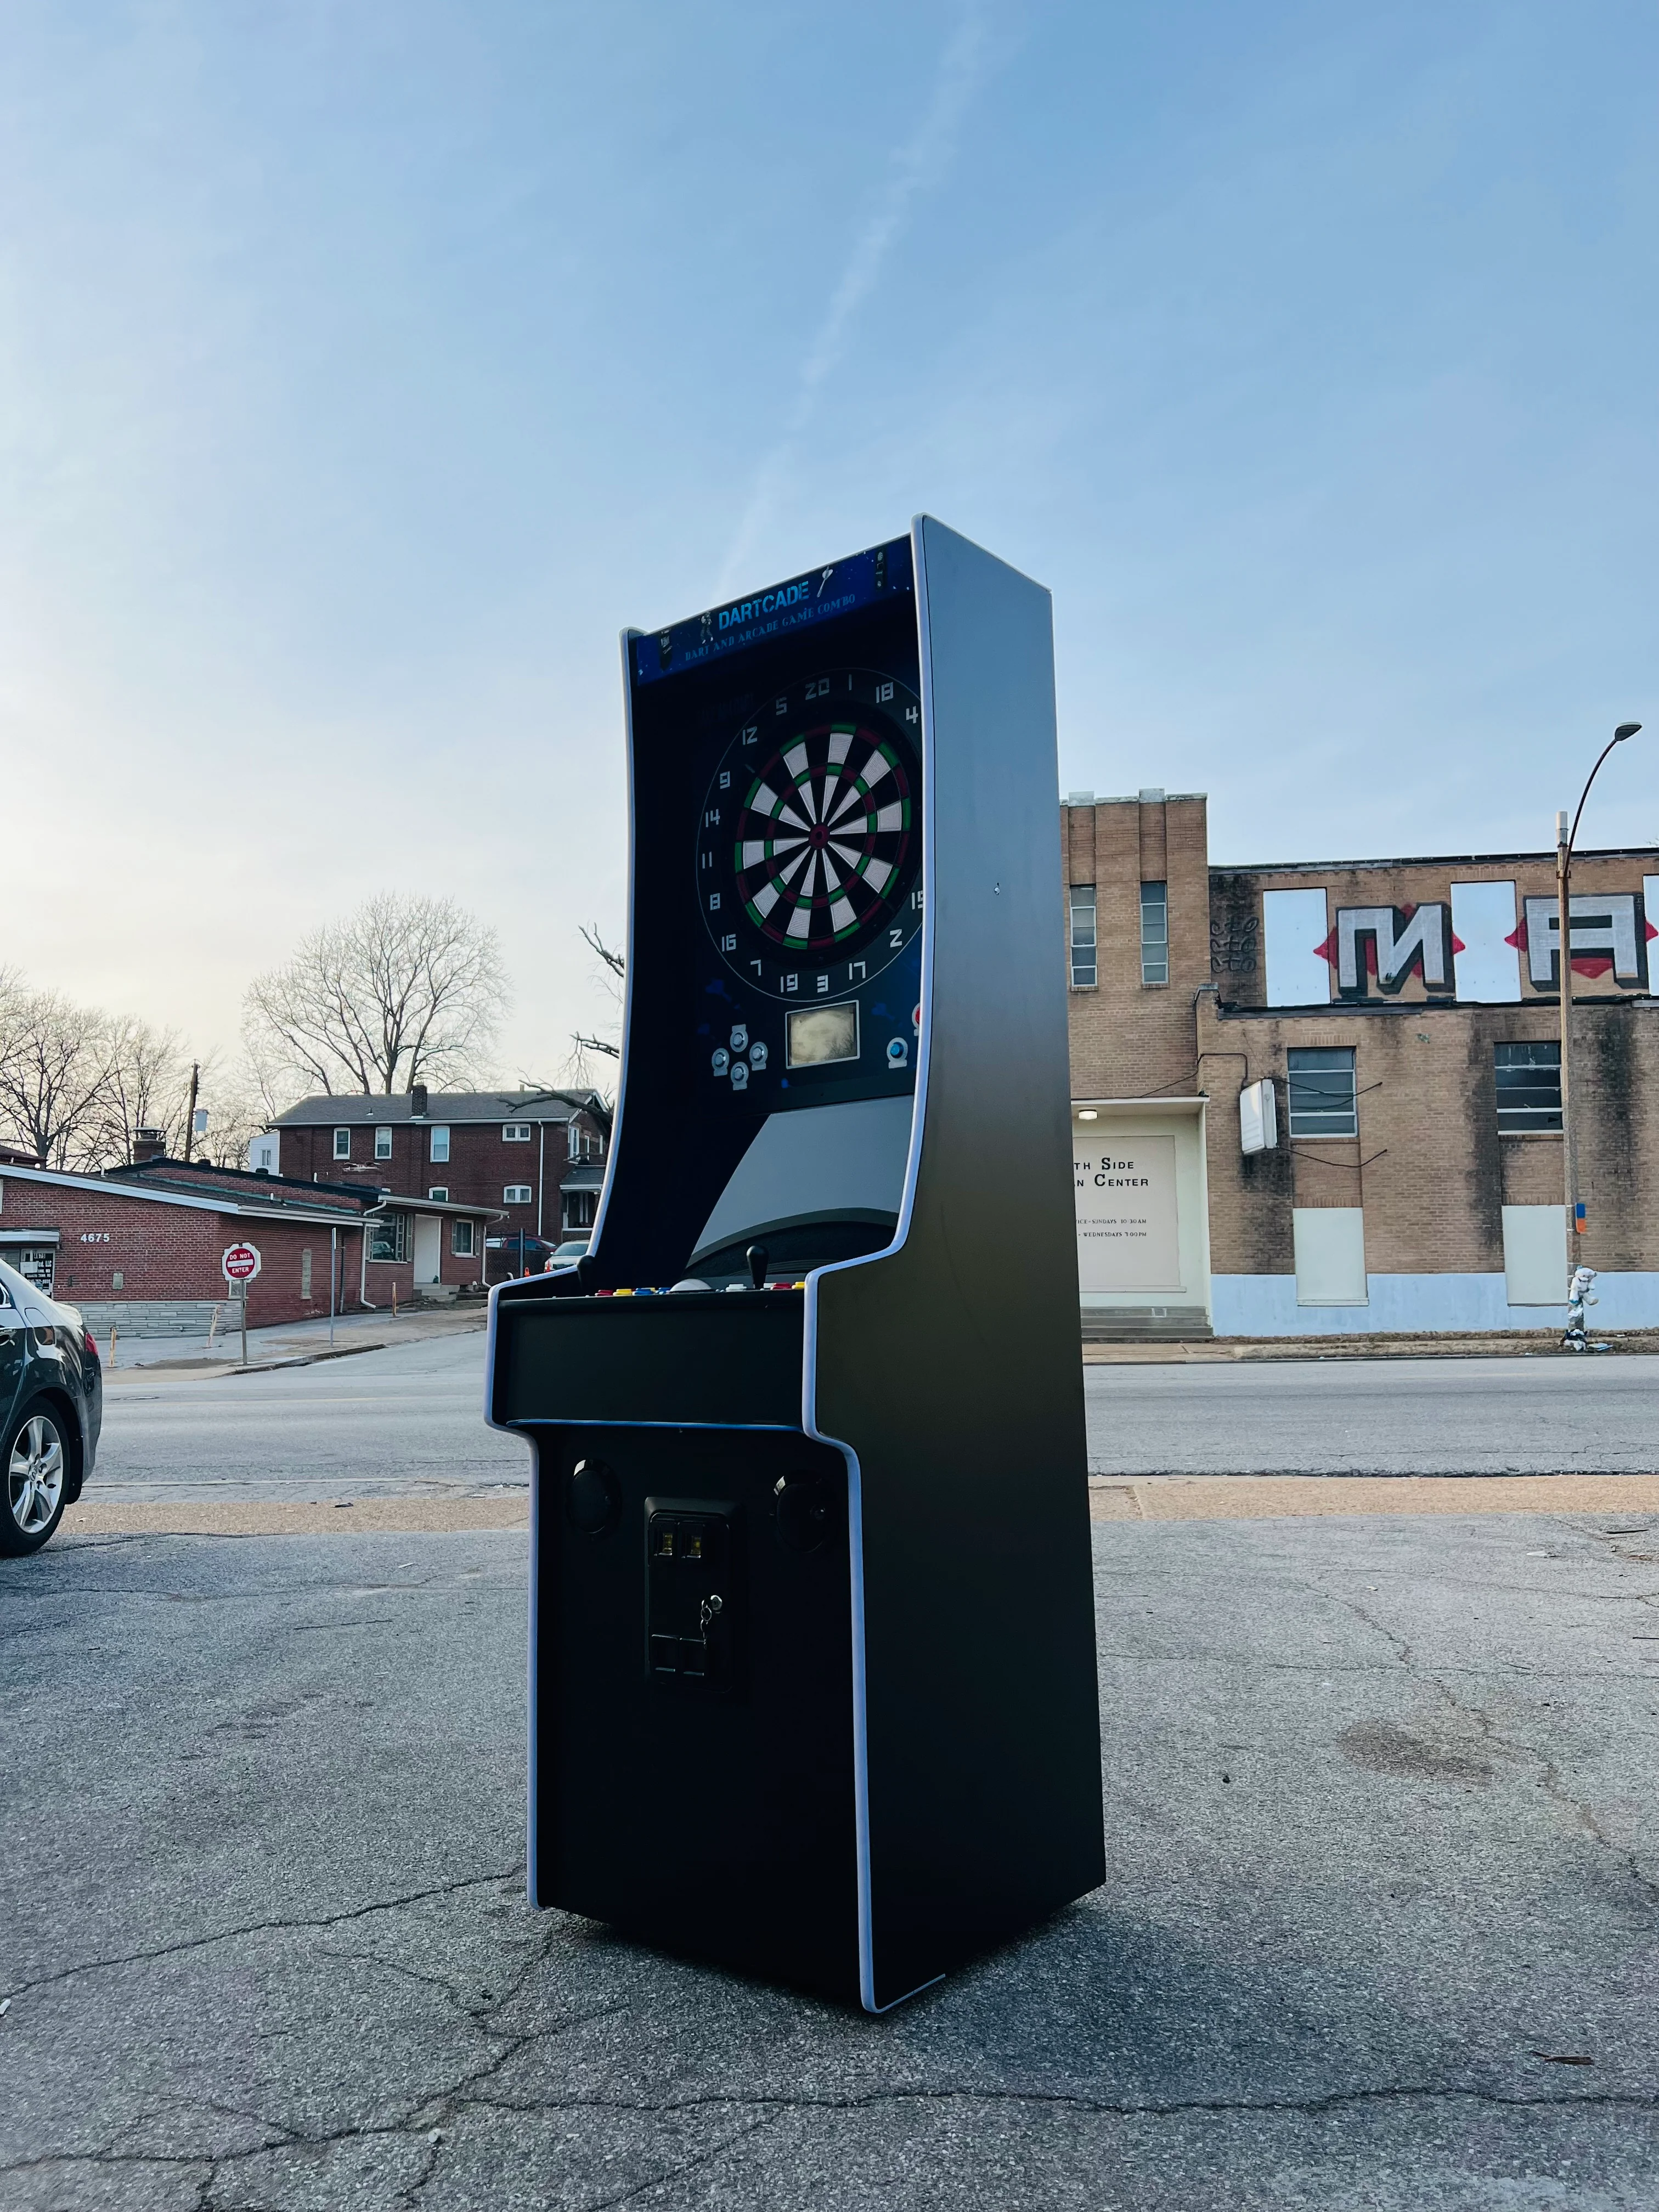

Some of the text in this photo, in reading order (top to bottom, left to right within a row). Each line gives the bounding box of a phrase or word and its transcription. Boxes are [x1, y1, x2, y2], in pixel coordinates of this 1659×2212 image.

[718, 581, 810, 630] DARTCADE
[685, 594, 856, 661] DART AND ARCADE GAME COMBO
[805, 678, 830, 700] 20
[849, 674, 852, 691] 1
[876, 682, 893, 703] 18
[776, 696, 787, 715] 5
[906, 706, 918, 724] 4
[742, 726, 758, 745] 12
[720, 771, 731, 789] 9
[706, 809, 720, 828] 14
[702, 851, 712, 868] 11
[710, 893, 720, 910] 8
[721, 934, 736, 952] 16
[890, 929, 902, 947] 2
[751, 960, 761, 976] 7
[849, 961, 866, 980] 17
[780, 973, 798, 992] 19
[817, 974, 828, 992] 3
[1101, 1157, 1134, 1170] SIDE
[1094, 1174, 1148, 1186] CENTER
[80, 1233, 110, 1243] 4675
